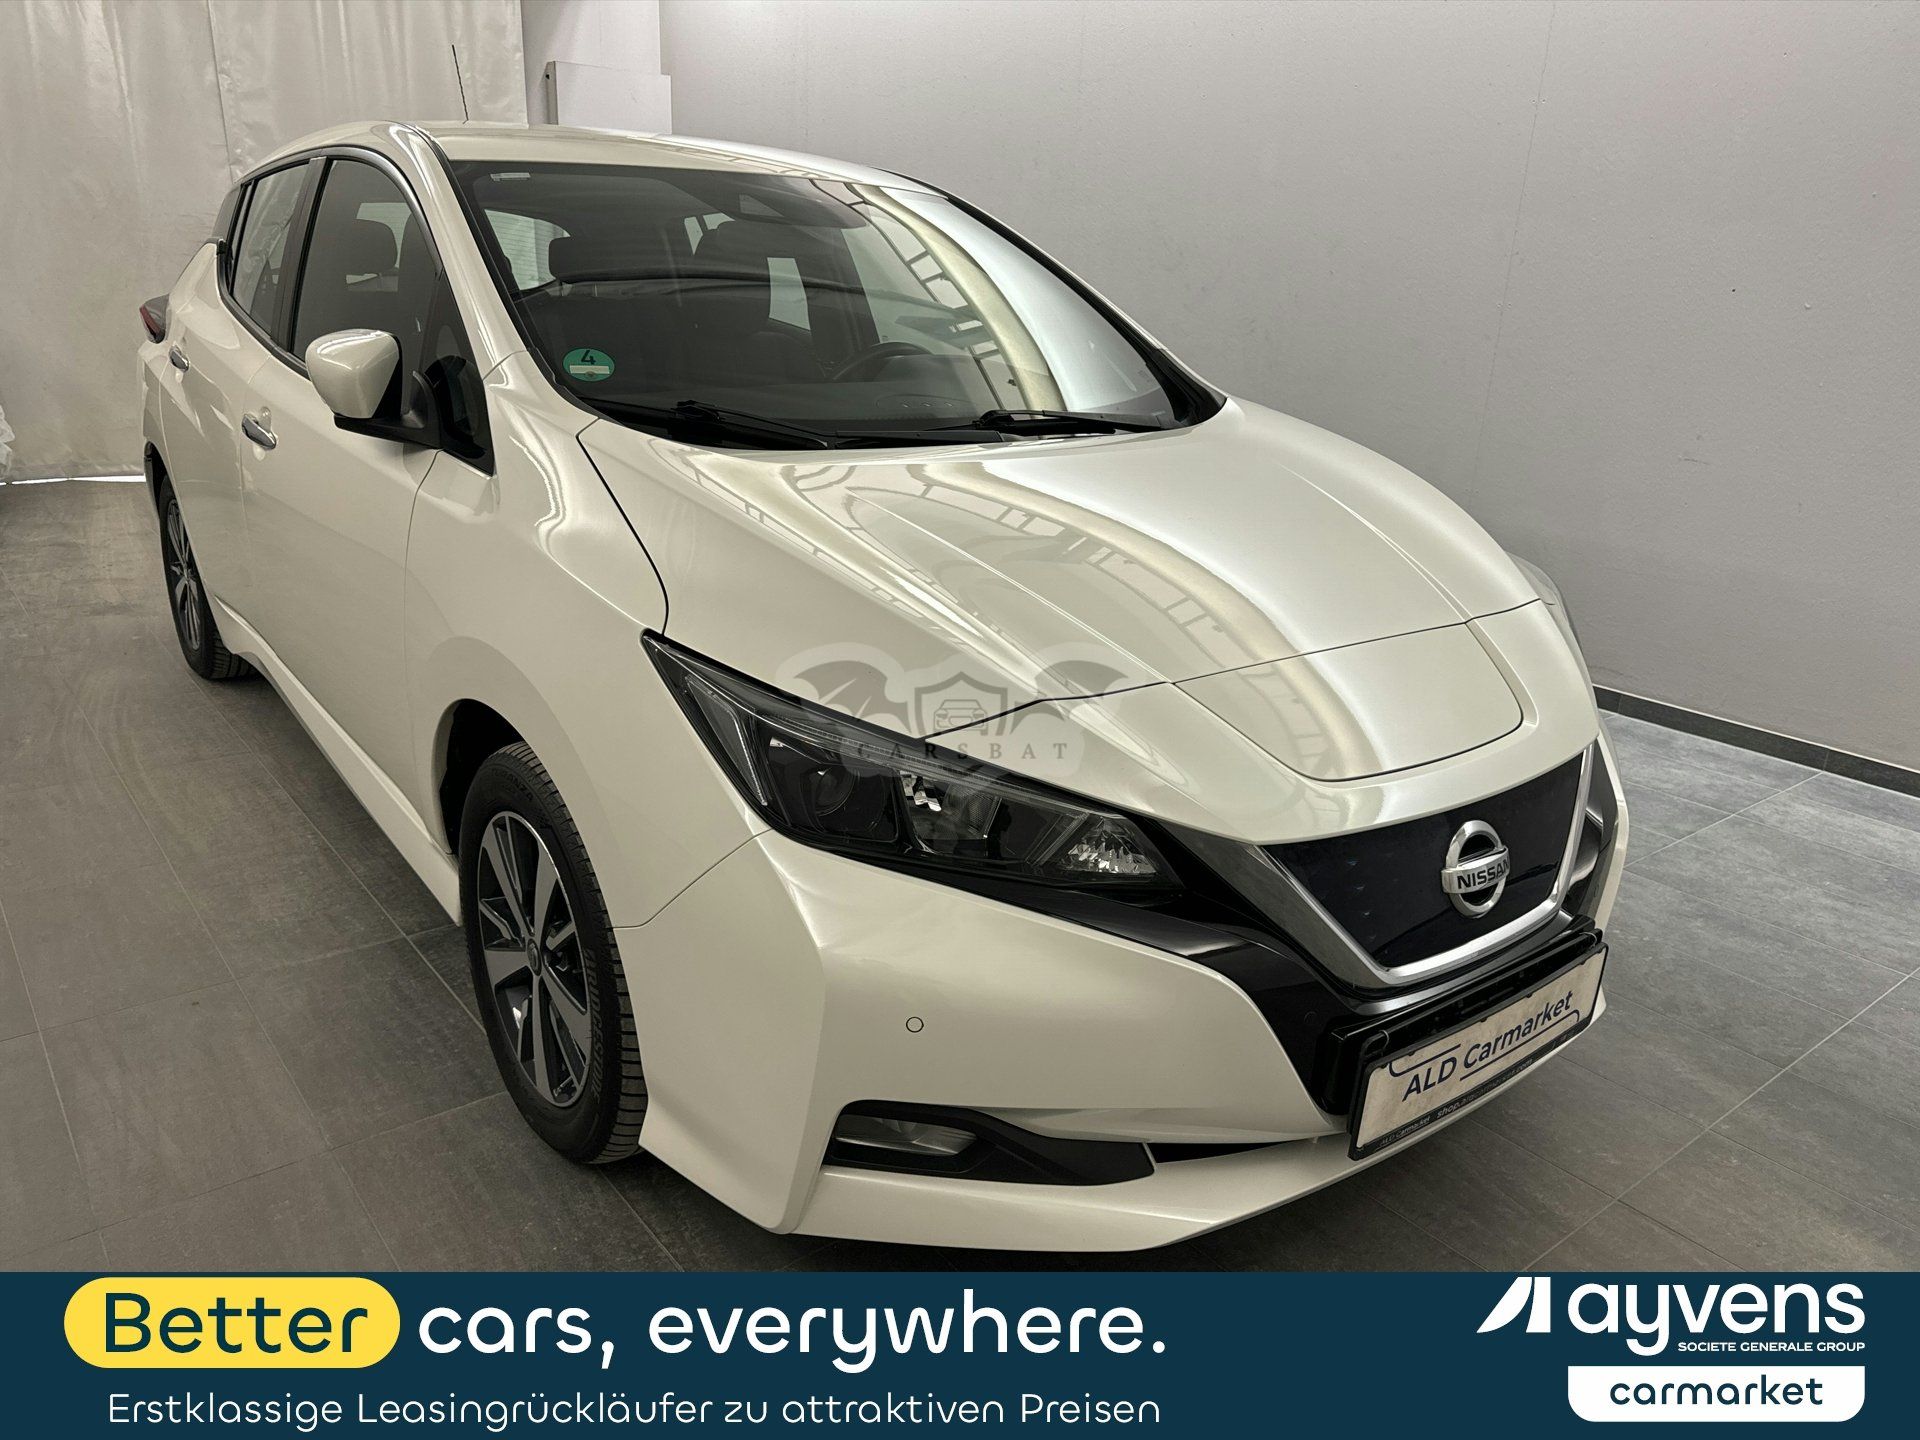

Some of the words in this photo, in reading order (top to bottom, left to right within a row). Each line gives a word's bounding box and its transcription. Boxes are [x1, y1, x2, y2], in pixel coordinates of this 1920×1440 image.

[580, 349, 597, 366] 4
[1457, 858, 1509, 890] NISSAN
[1402, 1056, 1458, 1102] ALD
[1463, 990, 1573, 1069] Carmarket
